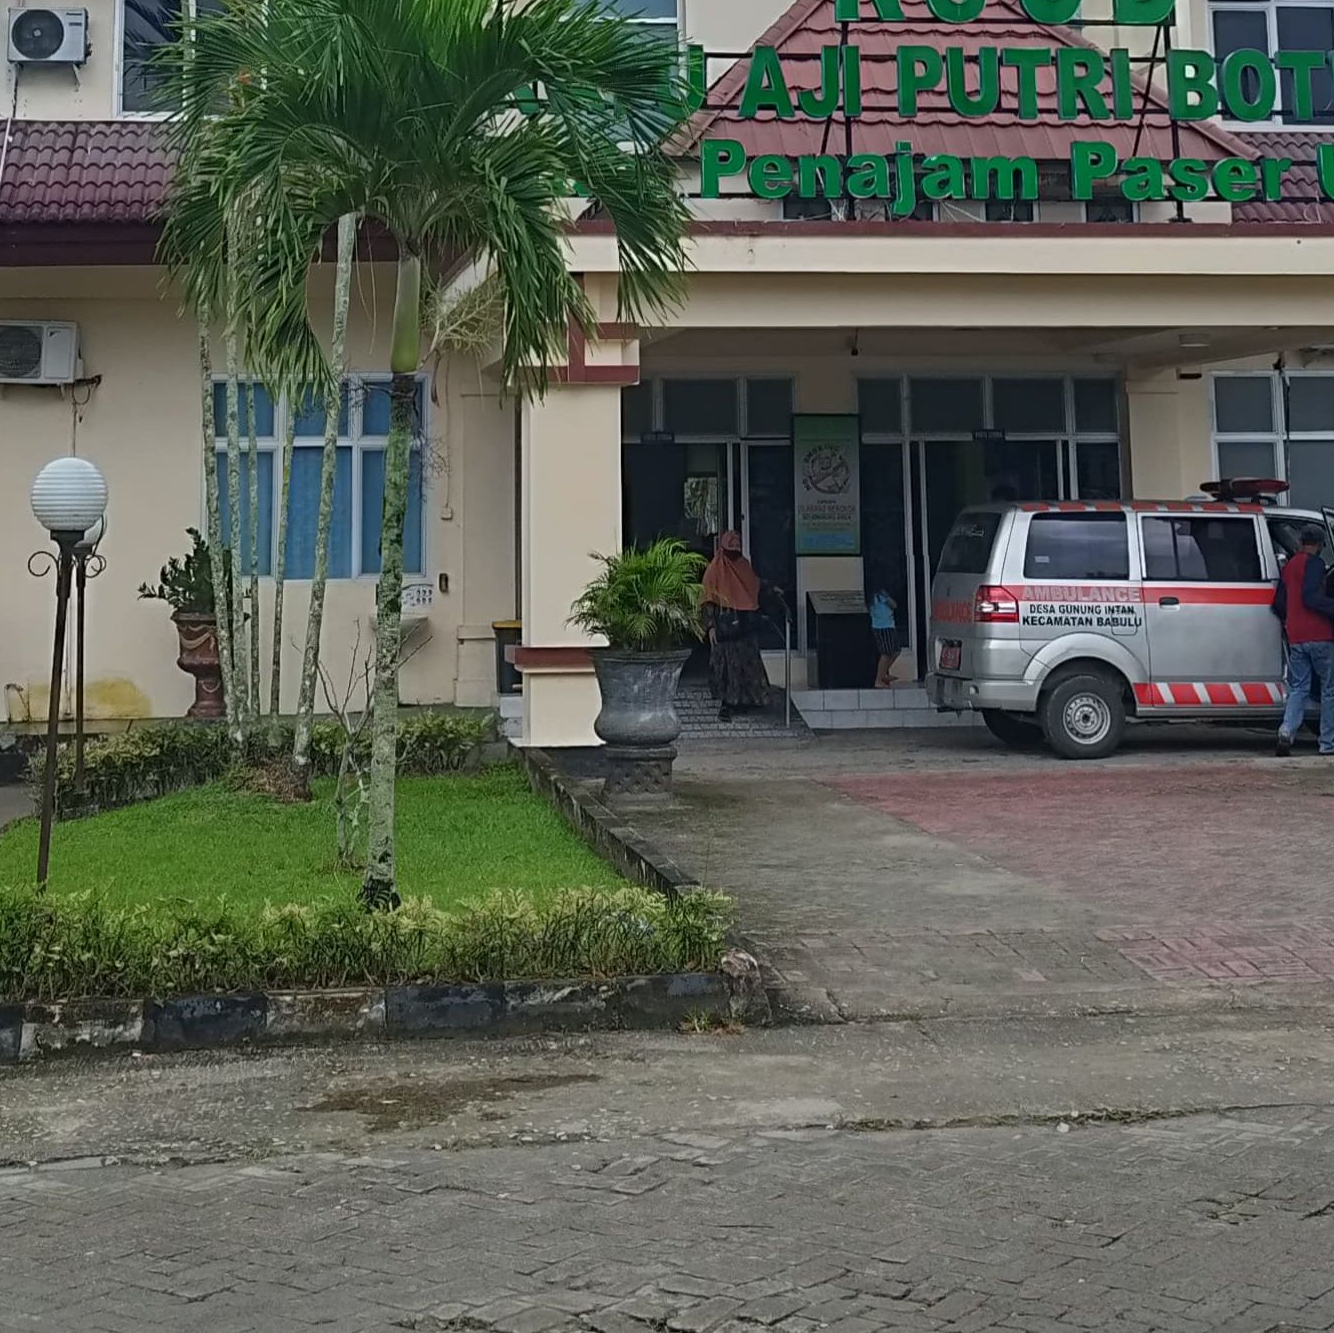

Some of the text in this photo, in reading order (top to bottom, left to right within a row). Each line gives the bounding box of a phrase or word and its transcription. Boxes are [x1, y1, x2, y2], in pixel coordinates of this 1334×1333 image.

[740, 45, 862, 119] AJI
[898, 45, 1135, 120] PUTRI
[699, 138, 1041, 216] Penajam
[1071, 140, 1293, 203] Paser
[1021, 586, 1141, 602] AMBULANCE
[1029, 604, 1135, 615] DESA GUNUNG INTAN
[1022, 616, 1142, 627] KECAMATAN BABULU
